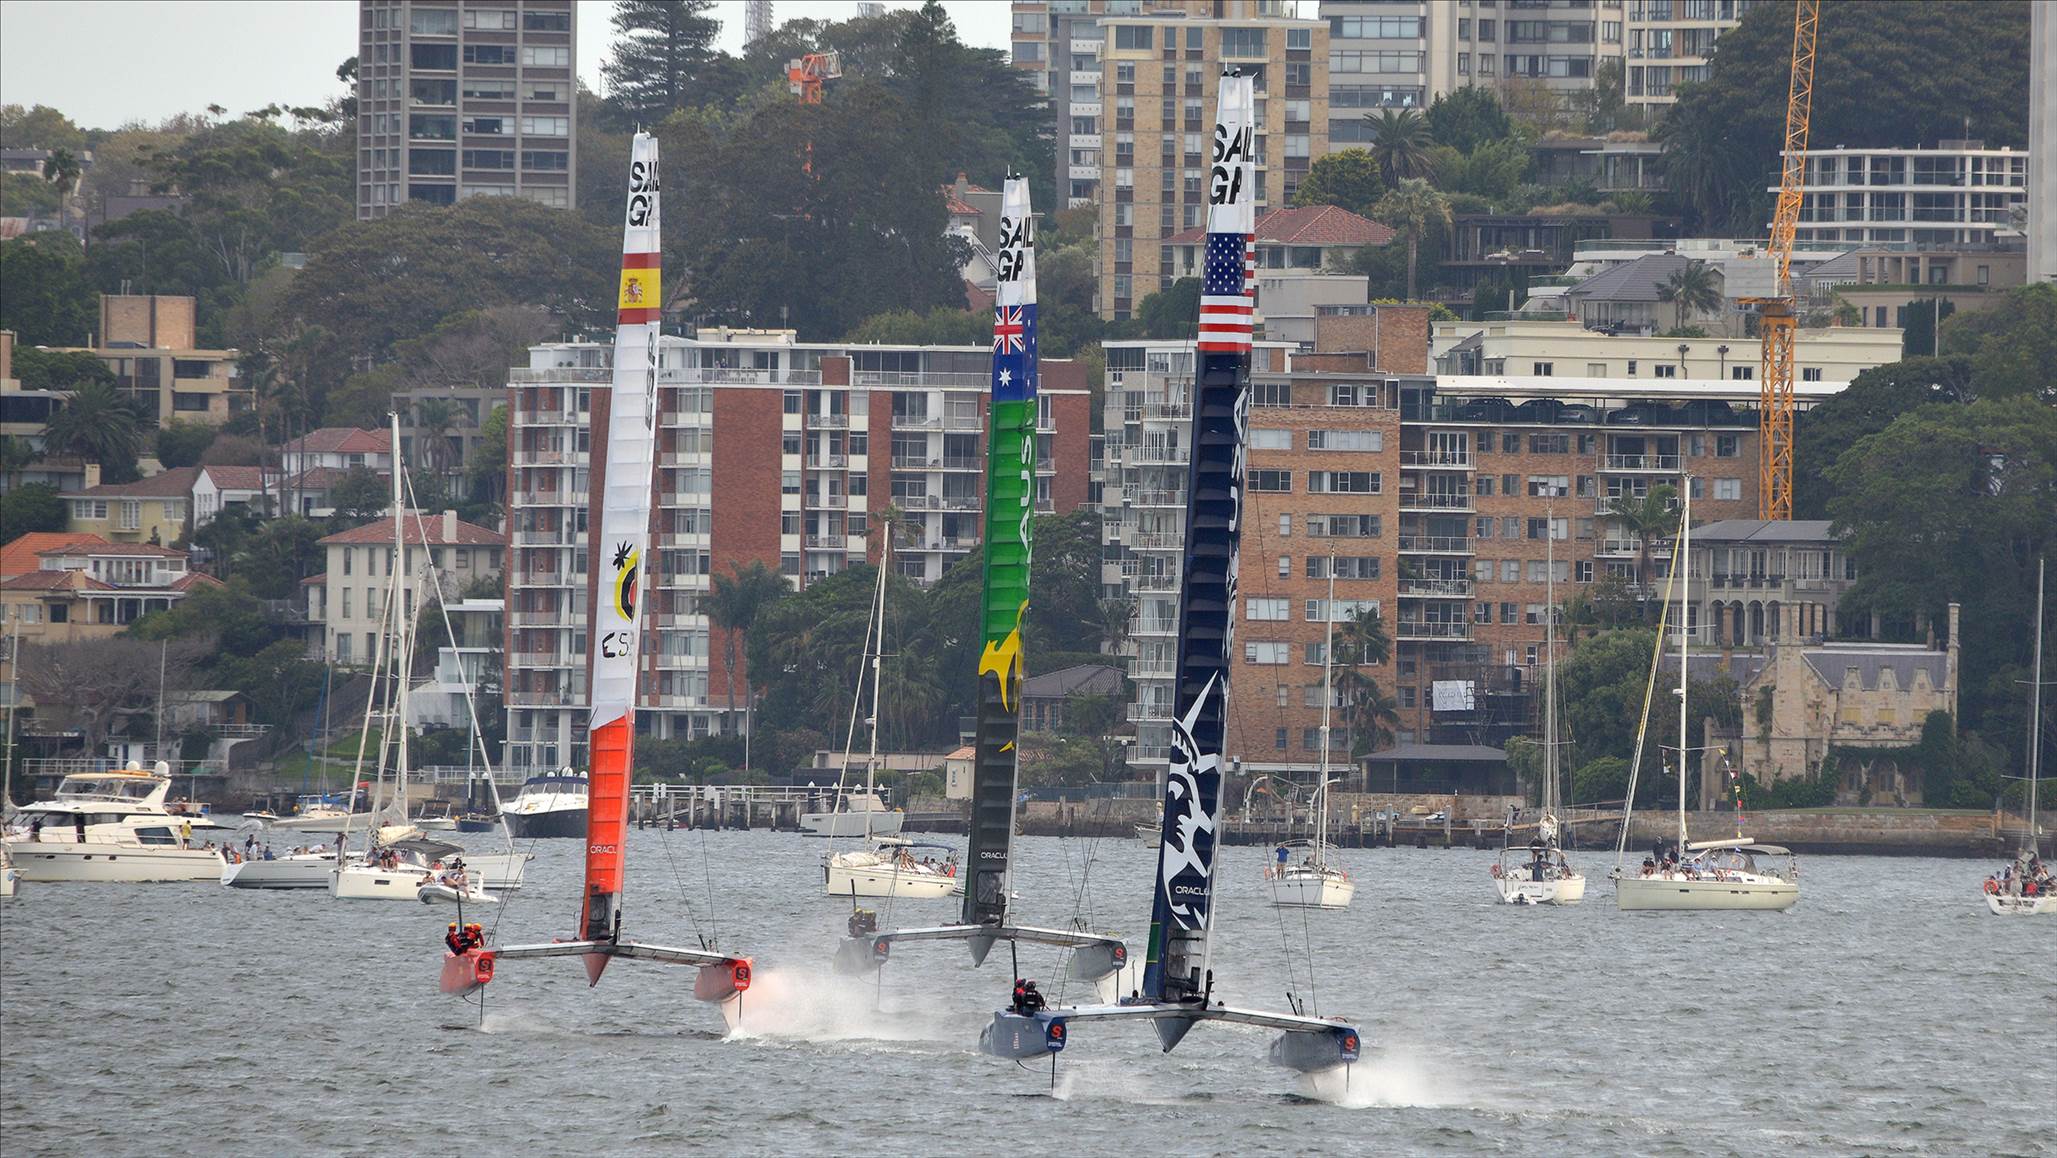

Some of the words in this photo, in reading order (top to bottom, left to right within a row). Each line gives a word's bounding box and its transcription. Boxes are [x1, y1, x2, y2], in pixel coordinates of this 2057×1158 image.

[1212, 124, 1254, 163] SAIL
[1000, 216, 1034, 249] SAIL
[998, 249, 1024, 282] GP
[1229, 387, 1248, 533] USA
[1020, 434, 1032, 552] AUS
[1051, 1025, 1063, 1038] S
[1344, 1036, 1357, 1050] S
